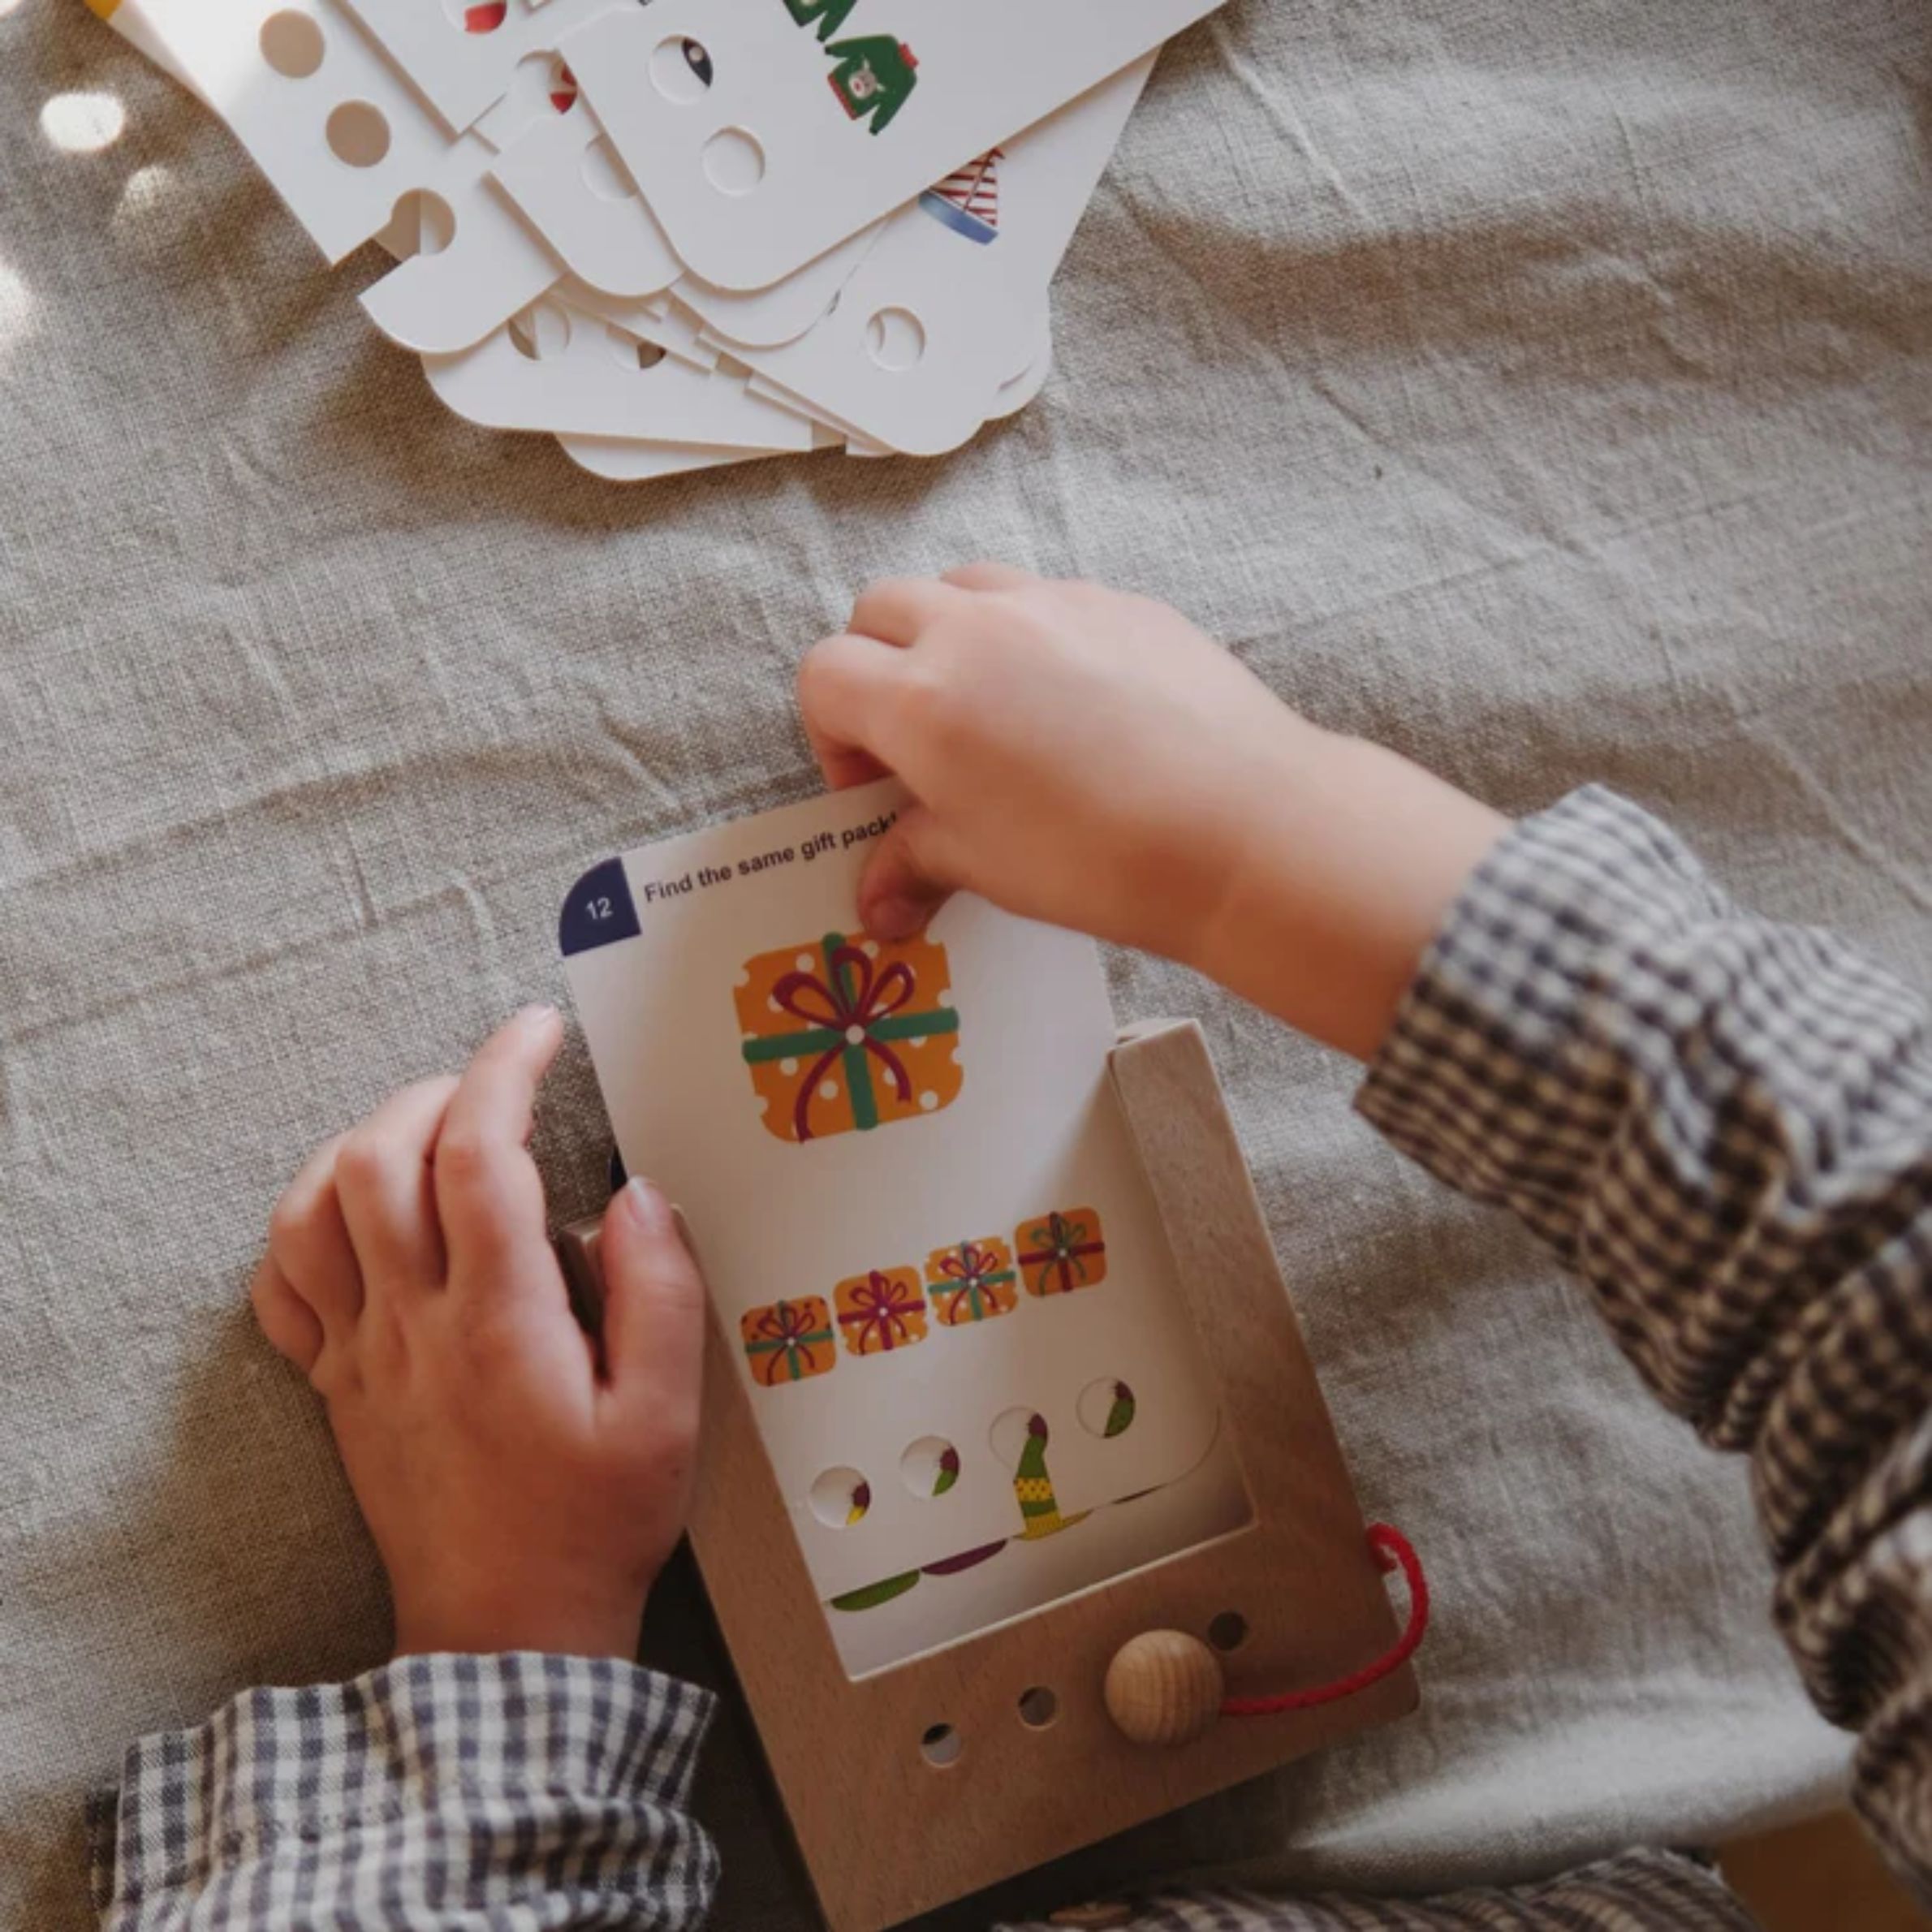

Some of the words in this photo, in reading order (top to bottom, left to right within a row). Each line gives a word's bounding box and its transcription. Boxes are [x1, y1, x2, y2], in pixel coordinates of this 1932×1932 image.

[644, 874, 693, 903] Find
[697, 865, 732, 887] the
[738, 848, 796, 876] same
[800, 832, 837, 860] gift
[585, 897, 614, 921] 12
